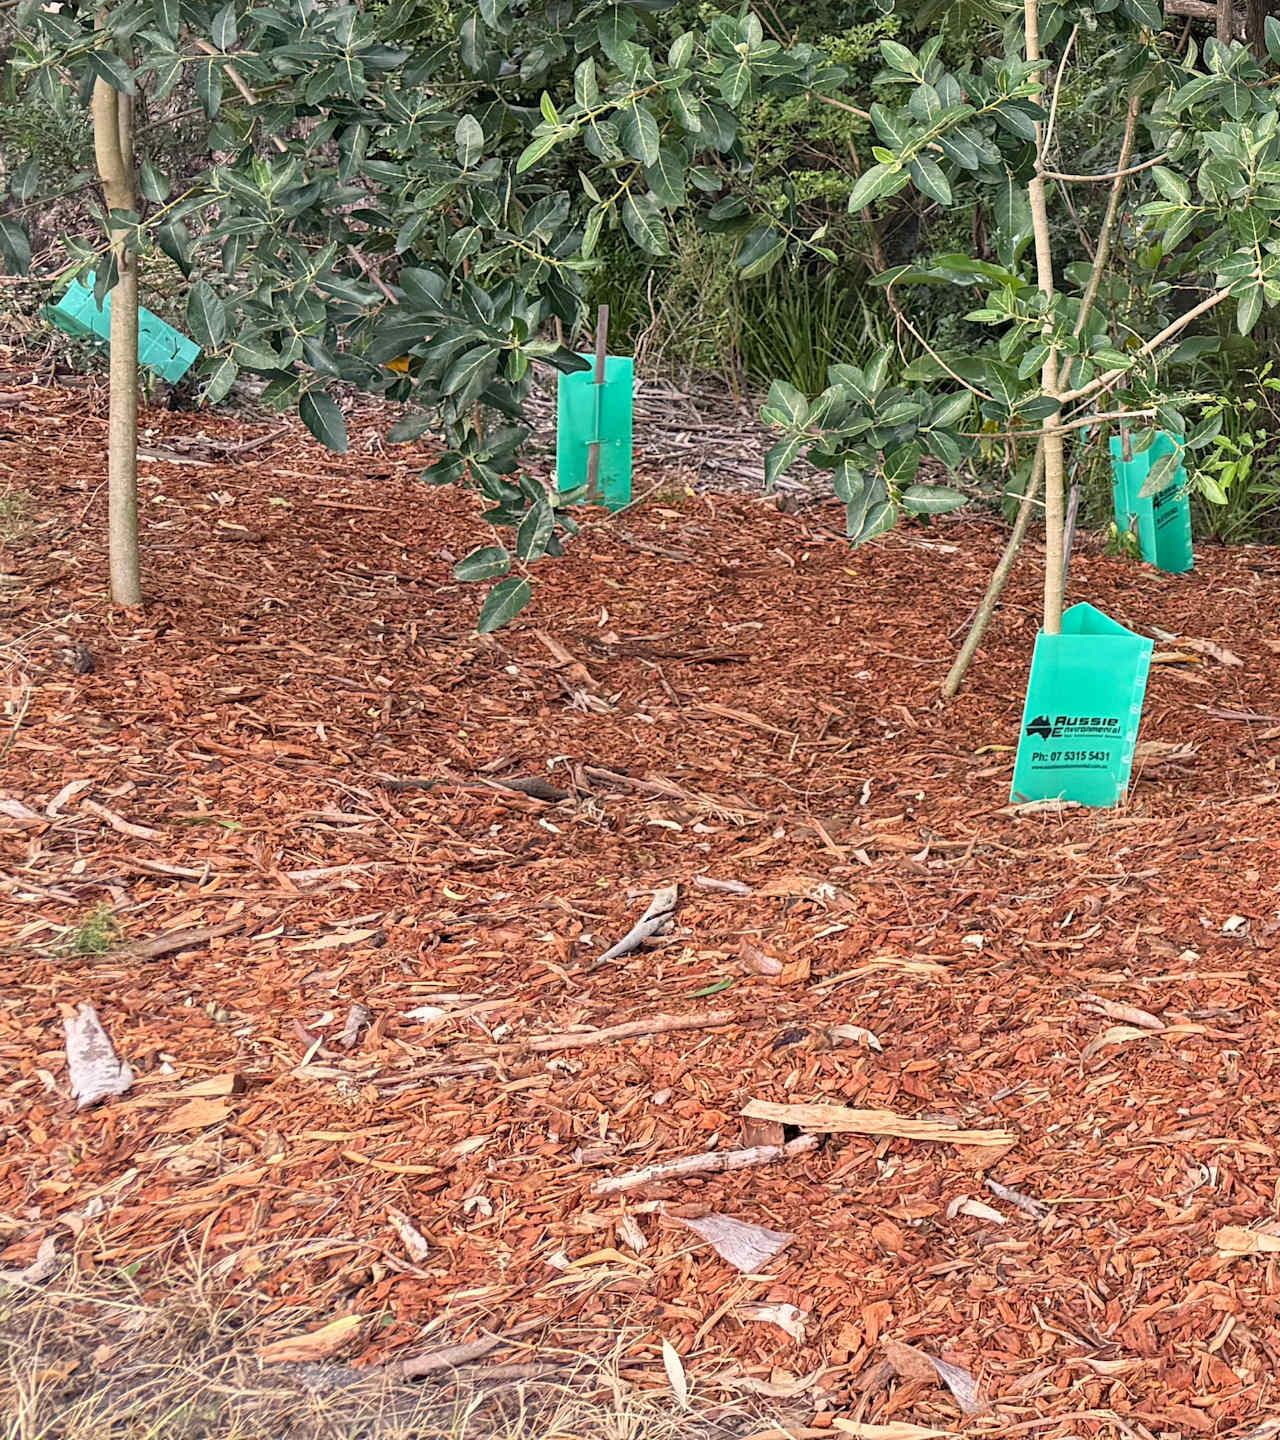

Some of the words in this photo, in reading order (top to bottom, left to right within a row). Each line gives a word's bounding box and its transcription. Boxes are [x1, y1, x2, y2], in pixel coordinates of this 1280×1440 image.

[1054, 716, 1119, 726] Aussie
[1032, 751, 1048, 762] Ph:
[1050, 751, 1062, 761] 07
[1063, 751, 1087, 761] 5315
[1088, 751, 1110, 761] 5431
